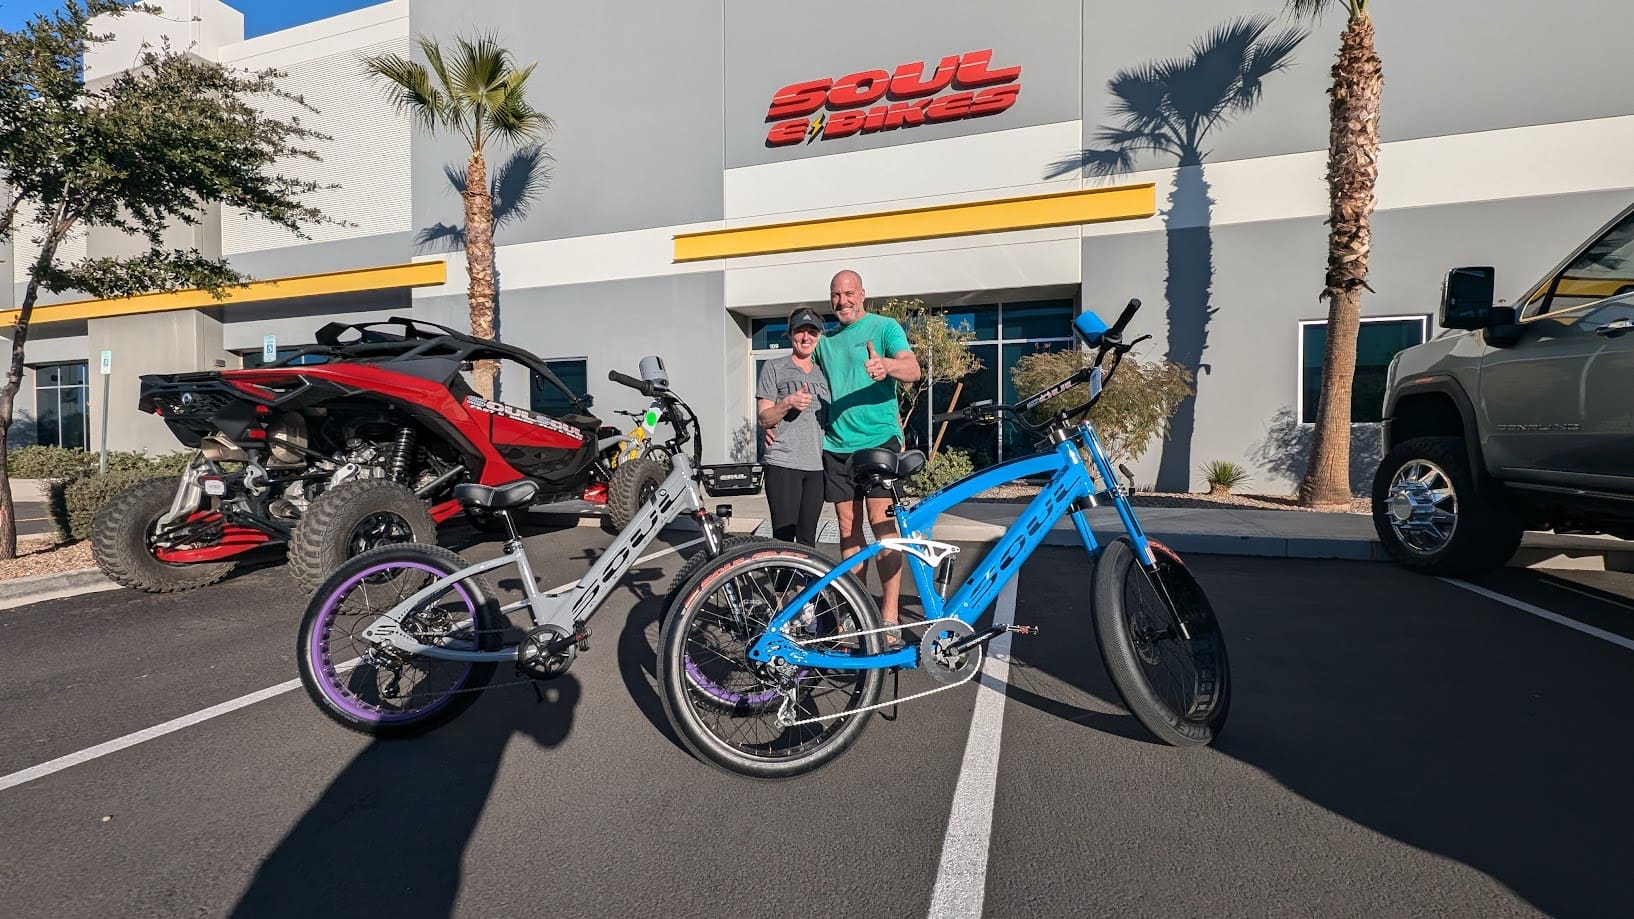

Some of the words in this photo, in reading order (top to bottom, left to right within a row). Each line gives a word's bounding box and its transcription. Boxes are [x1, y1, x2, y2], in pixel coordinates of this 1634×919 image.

[765, 48, 1021, 122] SOUL
[821, 84, 1020, 141] BIKES
[572, 485, 687, 621] SOUL
[968, 475, 1081, 609] SOUL
